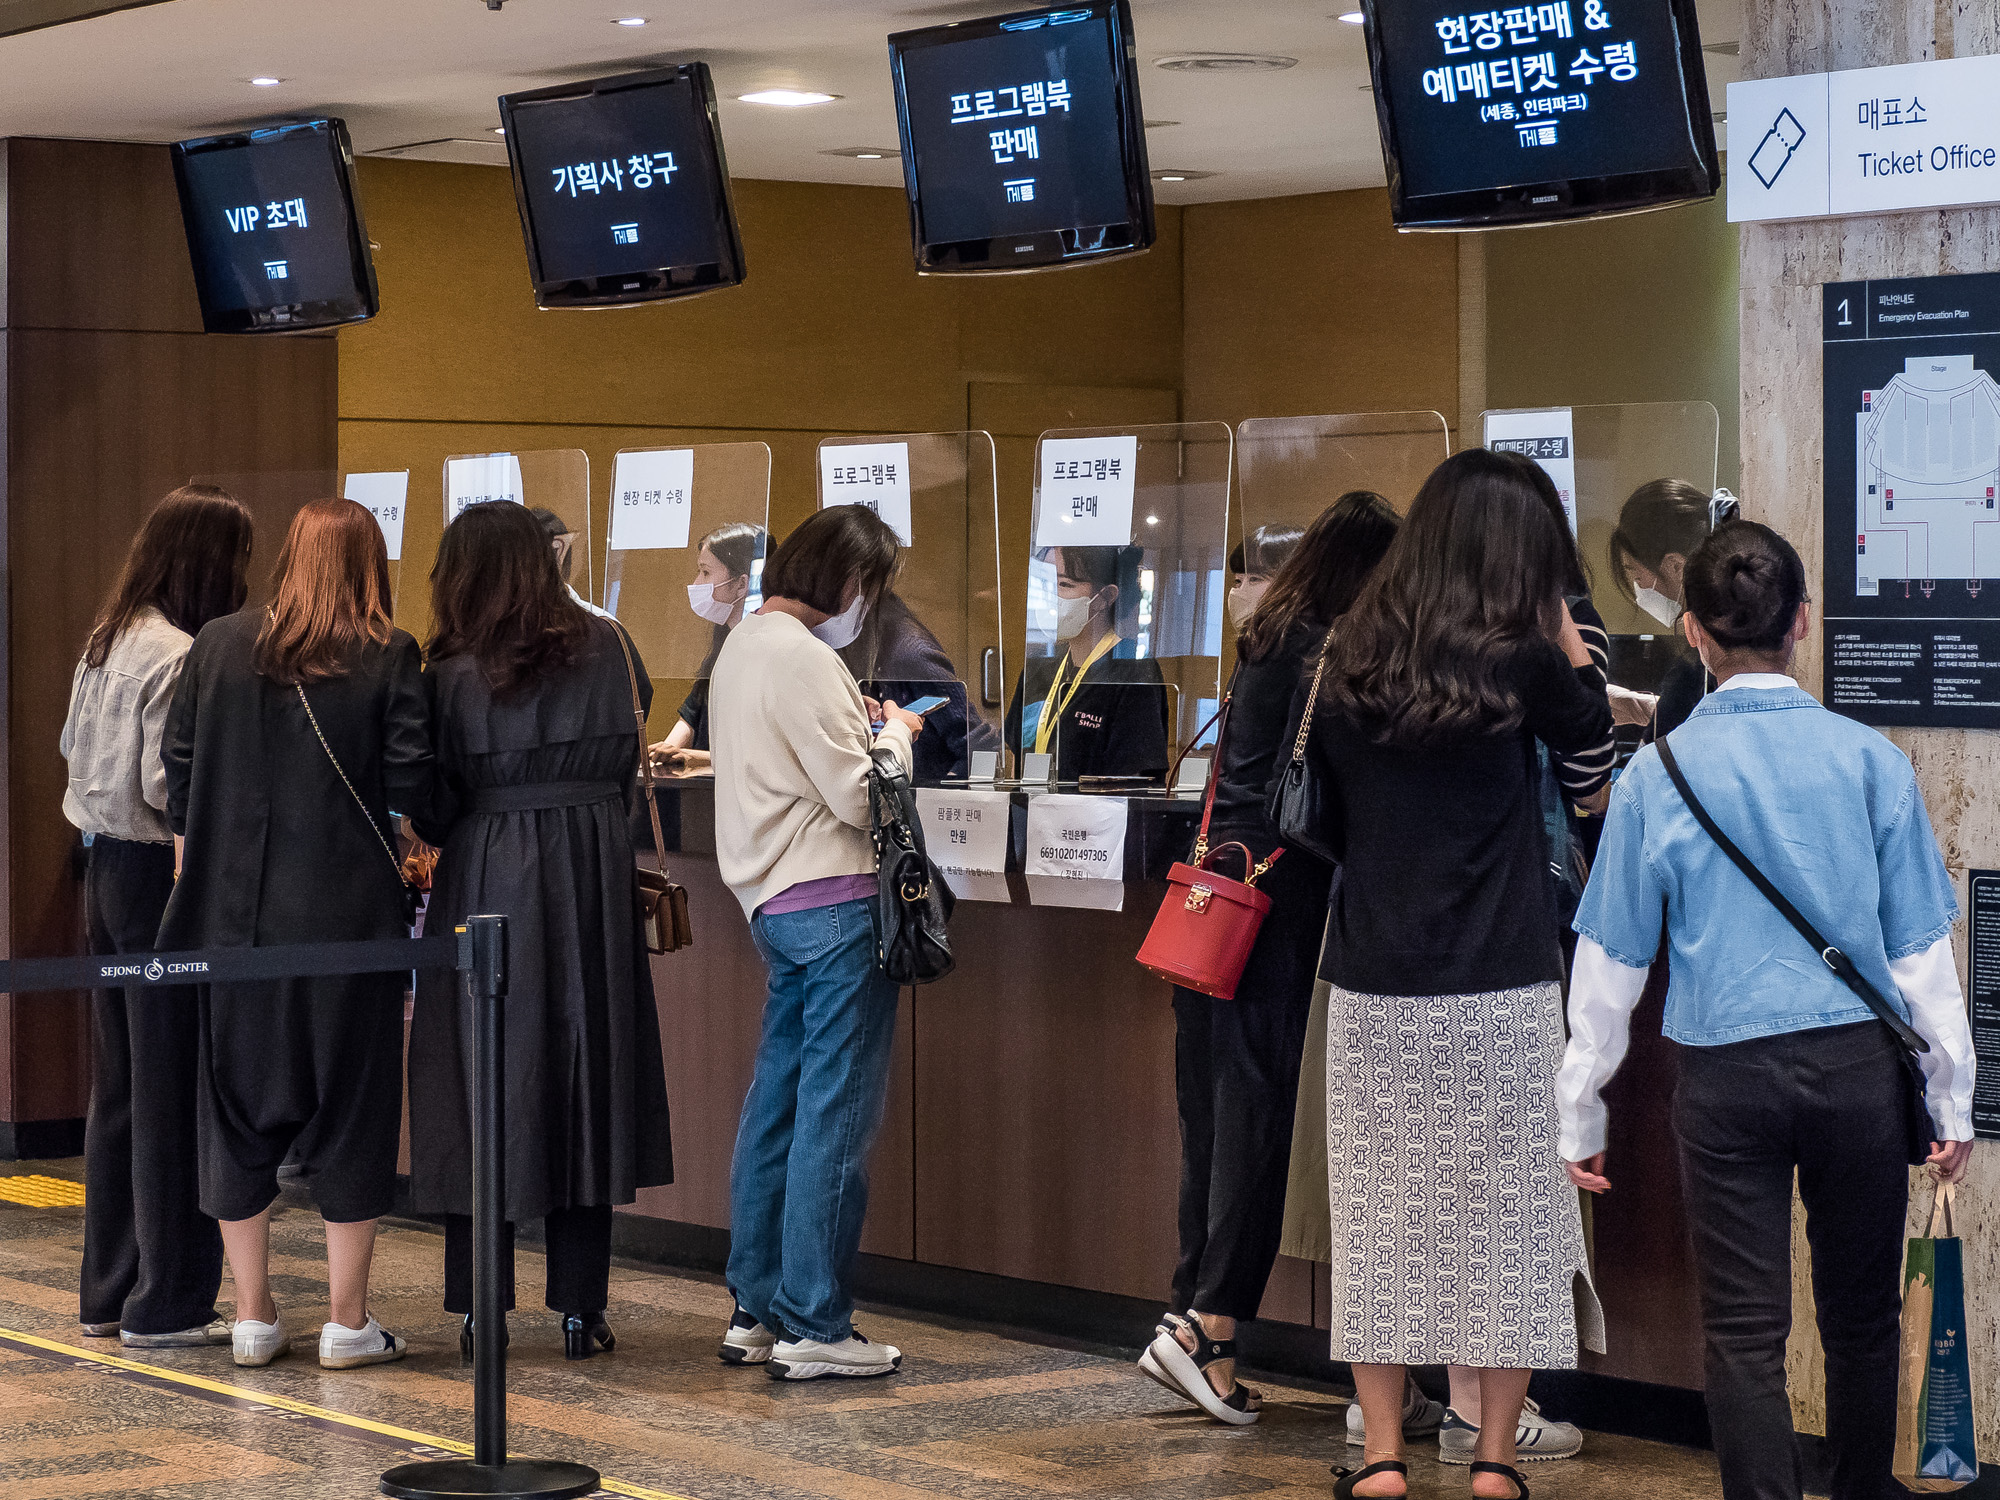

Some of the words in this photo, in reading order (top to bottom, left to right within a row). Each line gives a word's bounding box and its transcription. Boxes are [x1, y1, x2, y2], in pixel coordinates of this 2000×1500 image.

[1435, 0, 1574, 55] 현장판매
[1584, 0, 1612, 31] &
[1422, 52, 1559, 103] 예매티켓
[1569, 40, 1639, 85] 수령
[950, 79, 1072, 124] 프로그램북
[1480, 102, 1520, 123] (세종,
[1523, 93, 1589, 117] 인터파크)
[1858, 96, 1928, 130] 매표소
[989, 125, 1040, 164] 판매
[1858, 150, 1923, 177] Ticket
[1930, 144, 1996, 171] Office
[552, 158, 624, 198] 기획사
[628, 151, 678, 189] 창구
[225, 206, 260, 233] VIP
[266, 197, 308, 229] 초대
[1878, 293, 1915, 306] 피난안내도
[1837, 298, 1852, 326] 1
[1878, 313, 1916, 323] Emergency
[1917, 310, 1954, 320] Evacuation
[1954, 309, 1970, 318] Plan
[1540, 438, 1563, 457] 수령
[832, 463, 897, 485] 프로그램북
[1053, 457, 1122, 481] 프로그램북
[623, 490, 640, 506] 현장
[644, 489, 662, 505] 티켓
[666, 488, 683, 505] 수령
[1071, 495, 1098, 518] 판매
[382, 506, 398, 522] 수령
[937, 807, 961, 821] 팜플렛
[965, 808, 982, 822] 판매
[950, 828, 967, 844] 만원
[1061, 829, 1087, 841] 국민은행
[1040, 846, 1108, 862] 66910201497305
[100, 965, 141, 978] SEJONG
[167, 962, 209, 973] CENTER
